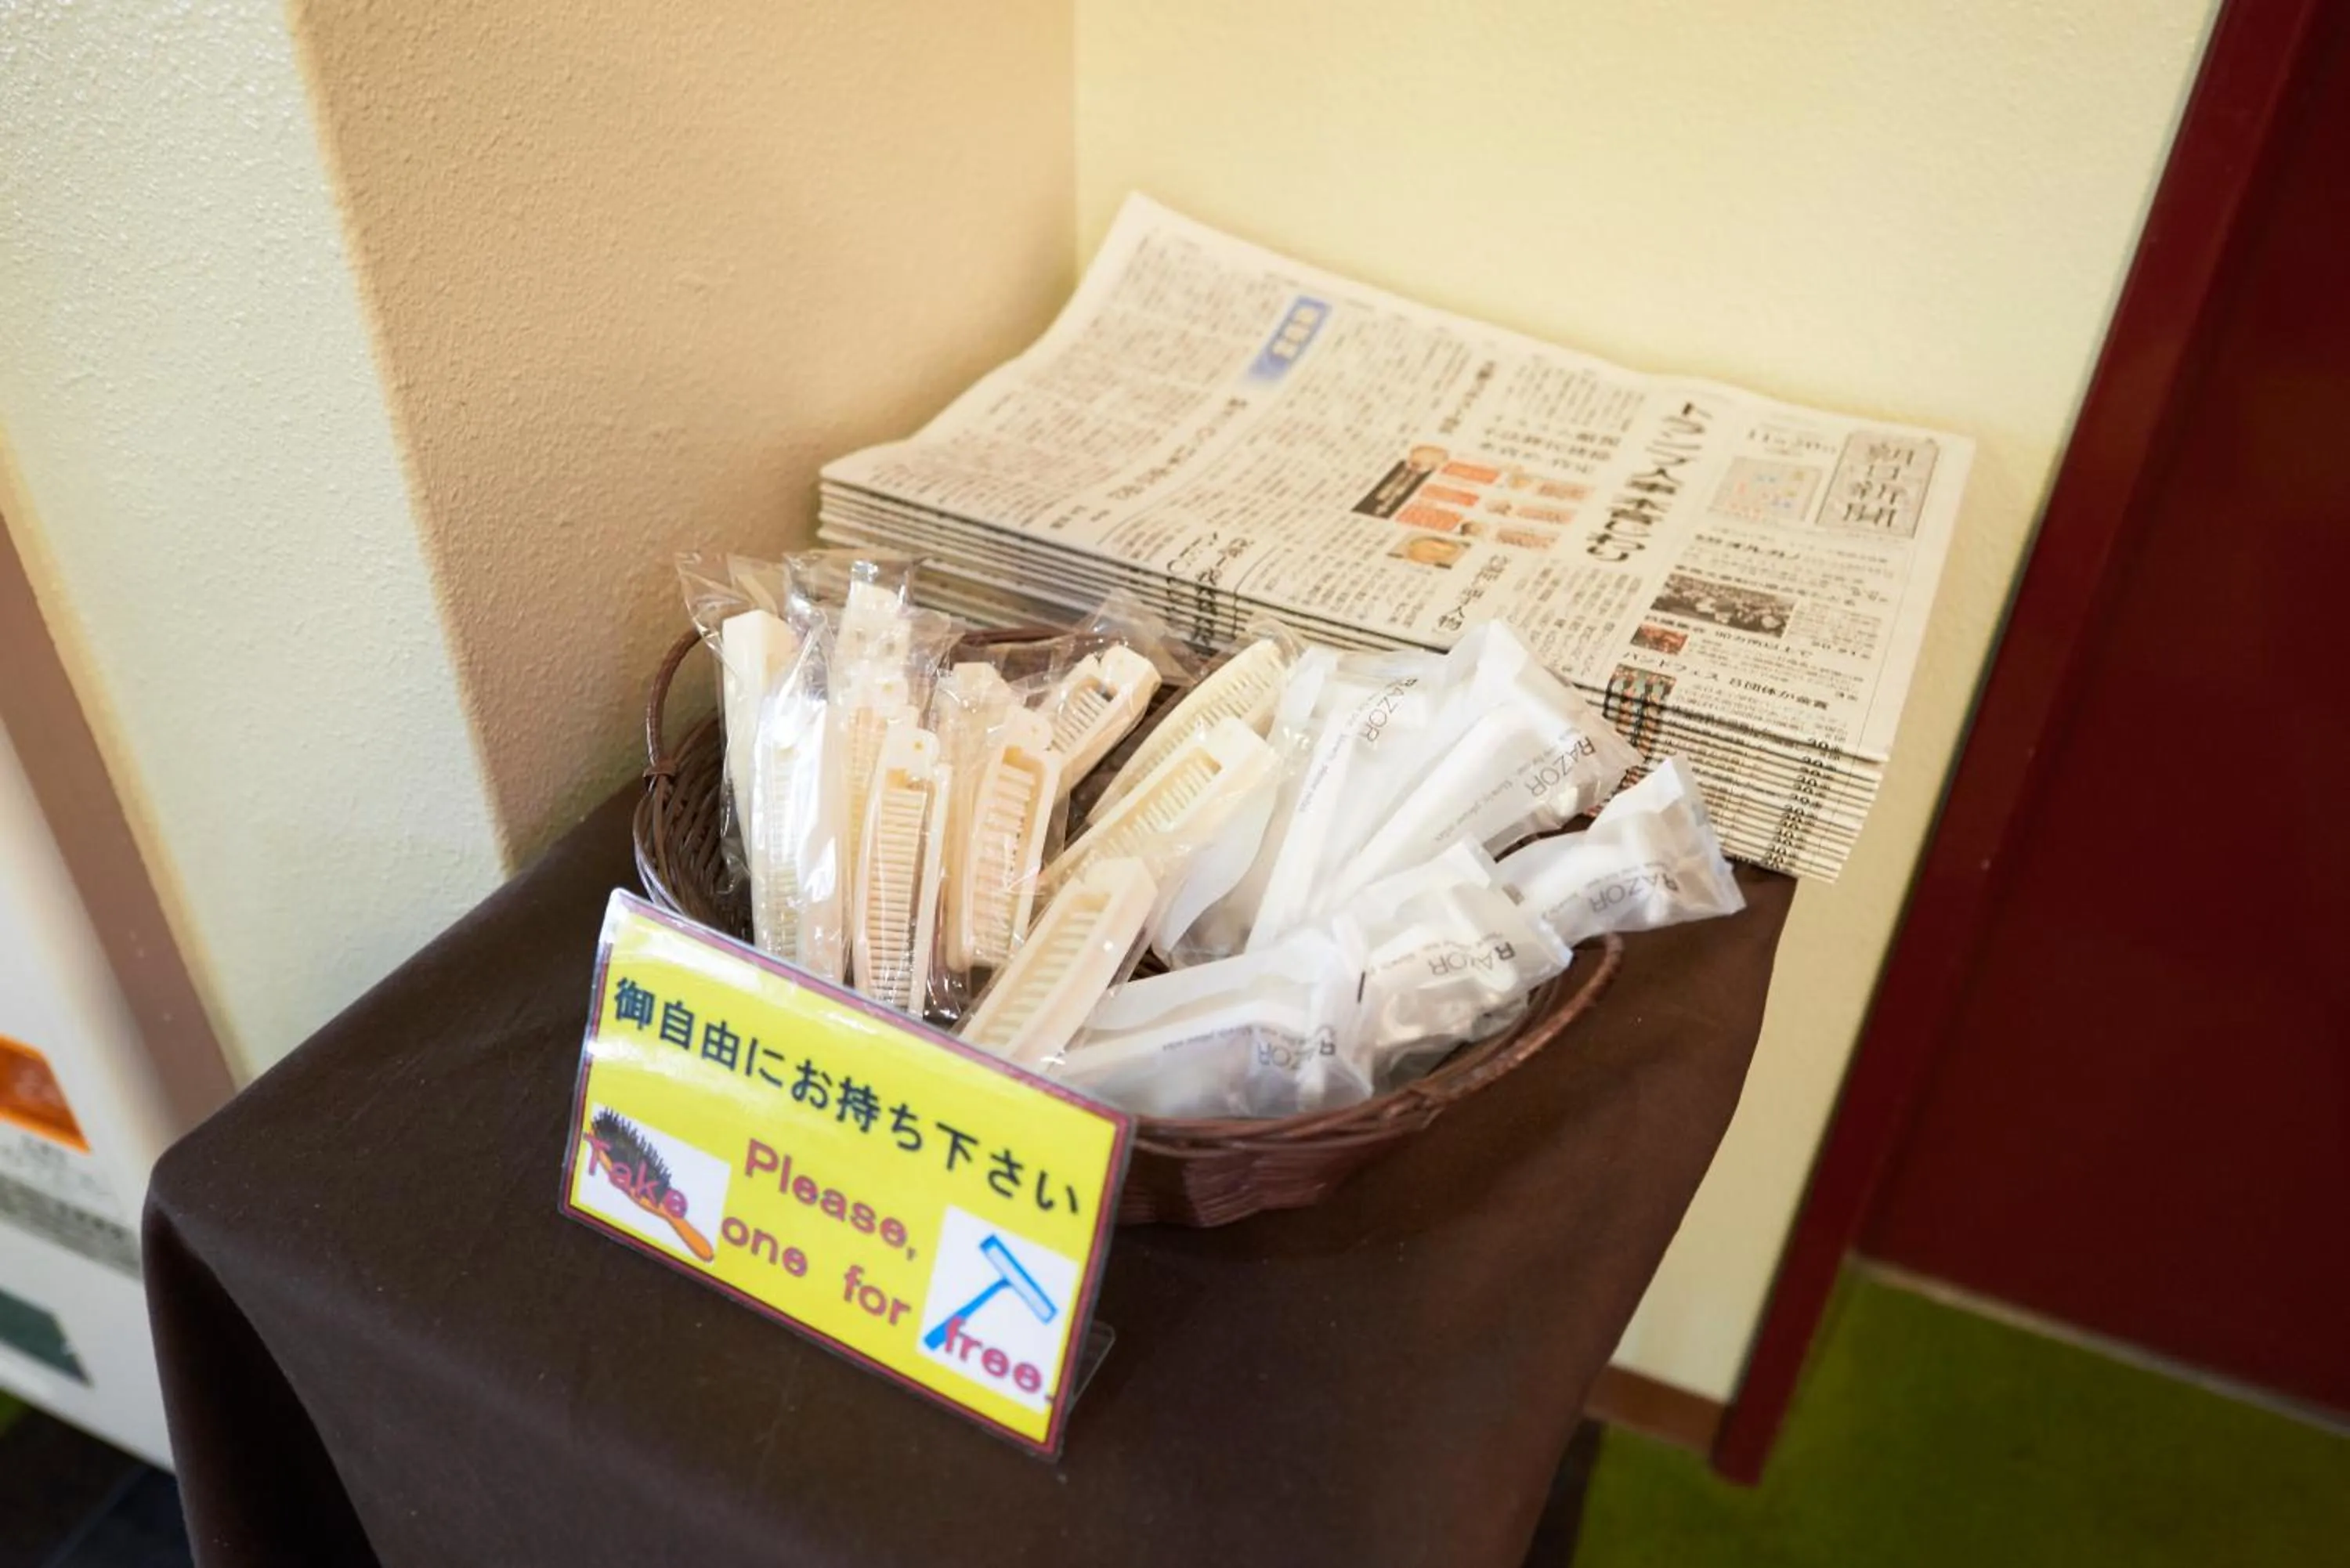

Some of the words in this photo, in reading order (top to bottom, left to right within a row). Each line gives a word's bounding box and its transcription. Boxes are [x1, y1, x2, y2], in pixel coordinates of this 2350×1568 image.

[1358, 677, 1419, 742] RAZOR
[1524, 735, 1596, 797] RAZOR
[1589, 873, 1679, 914] RAZOR
[1428, 941, 1517, 976] RAZOR
[613, 976, 1080, 1216] 御自由にお持ち下さい
[745, 1137, 916, 1262] Please,
[583, 1132, 689, 1219] Take
[721, 1213, 809, 1277] one
[843, 1264, 912, 1327] for
[944, 1316, 1054, 1402] free.
